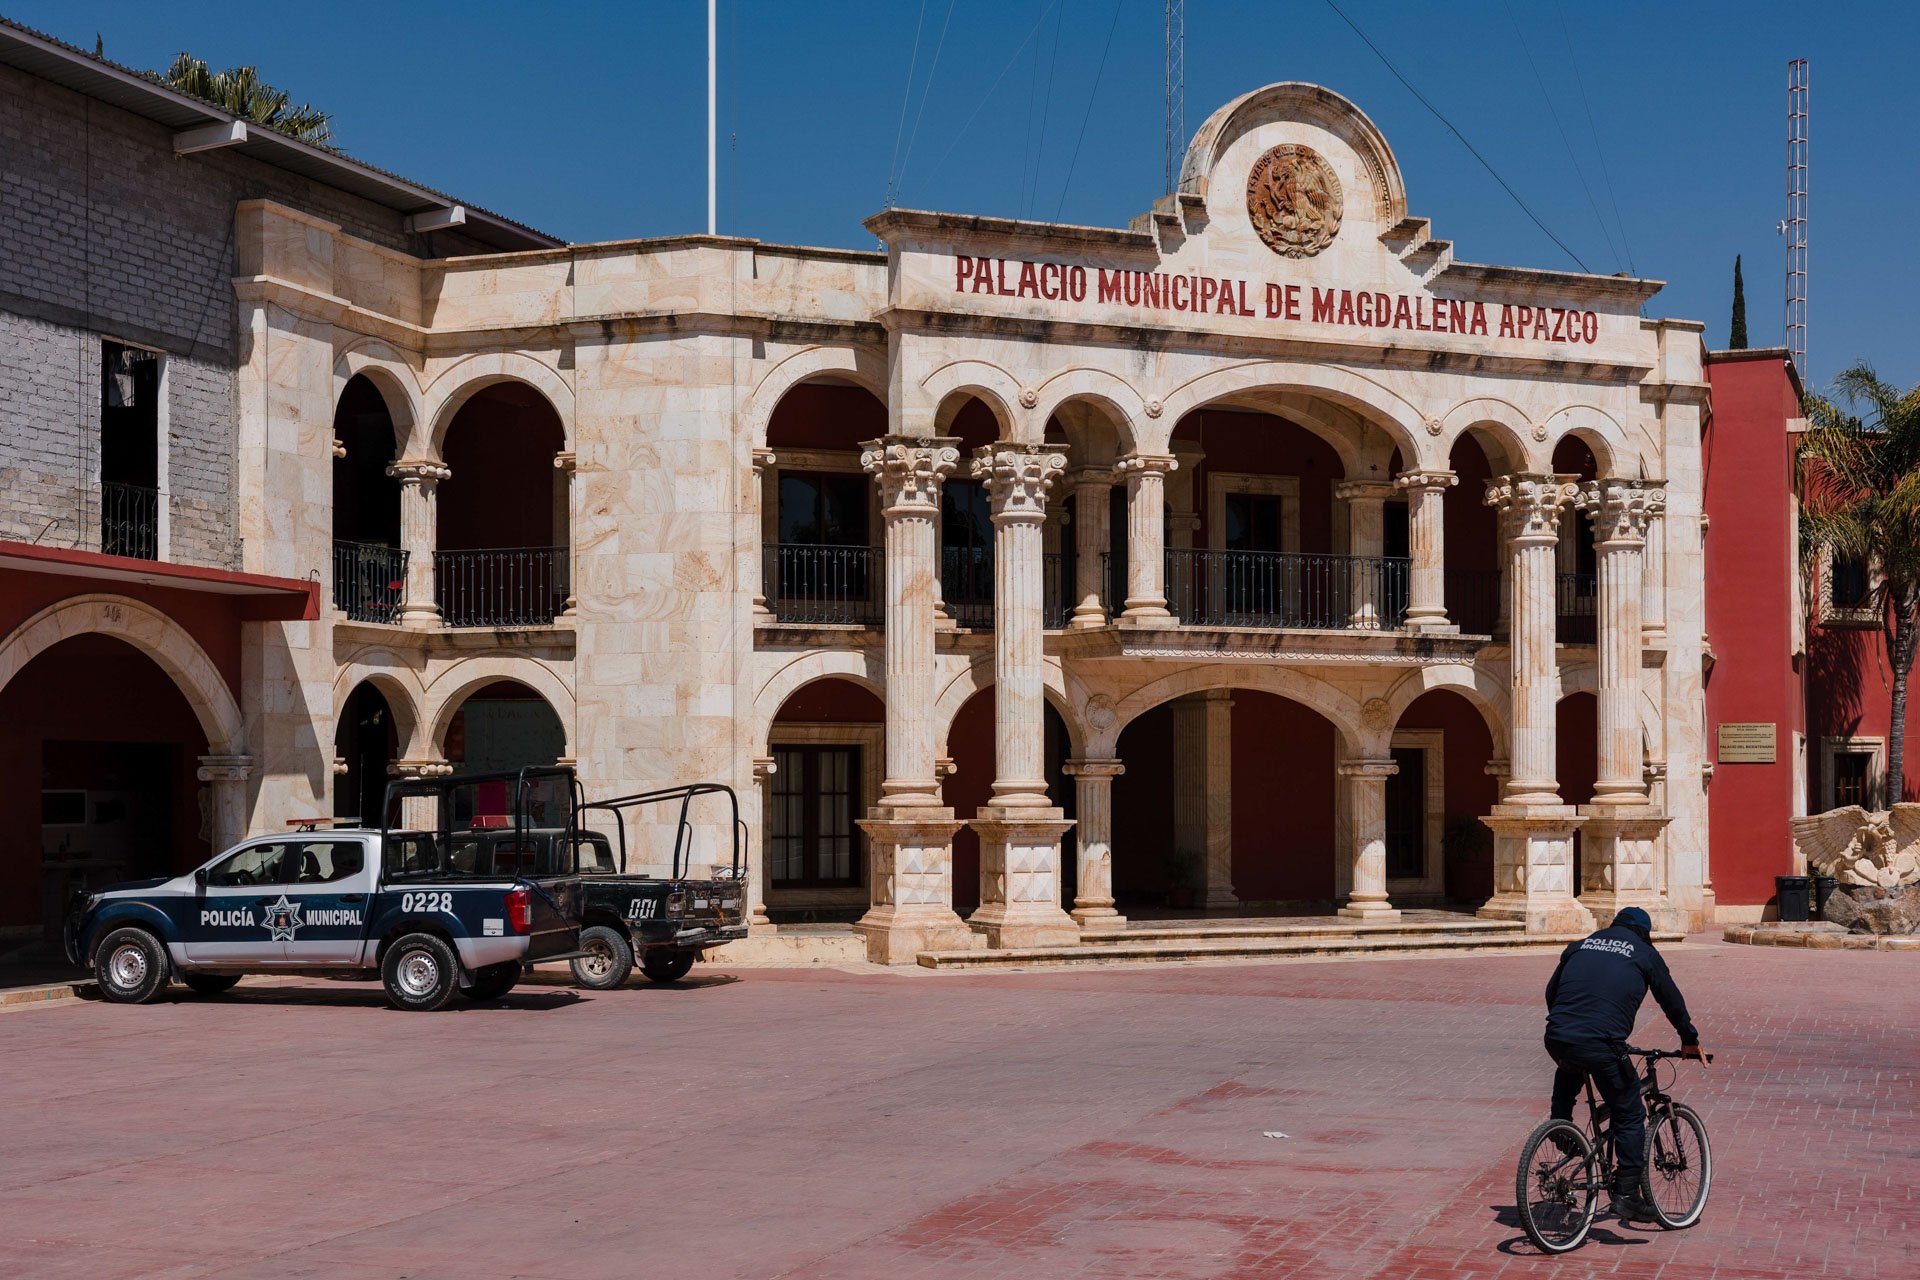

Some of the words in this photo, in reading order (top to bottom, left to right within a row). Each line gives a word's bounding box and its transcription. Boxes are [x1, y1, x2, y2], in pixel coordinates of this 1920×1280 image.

[955, 254, 1087, 303] PALACIO
[1098, 267, 1256, 317] MUNICIPAL
[1266, 282, 1301, 321] DE
[1311, 286, 1489, 336] MAGDALENA
[1498, 303, 1598, 345] APAZCO
[401, 892, 453, 913] 0228
[628, 898, 658, 919] 001
[200, 906, 255, 927] POLICÍA
[306, 909, 363, 926] MUNICIPAL
[1580, 943, 1632, 958] MUNICIPAL
[1583, 938, 1635, 952] POLICÍA
